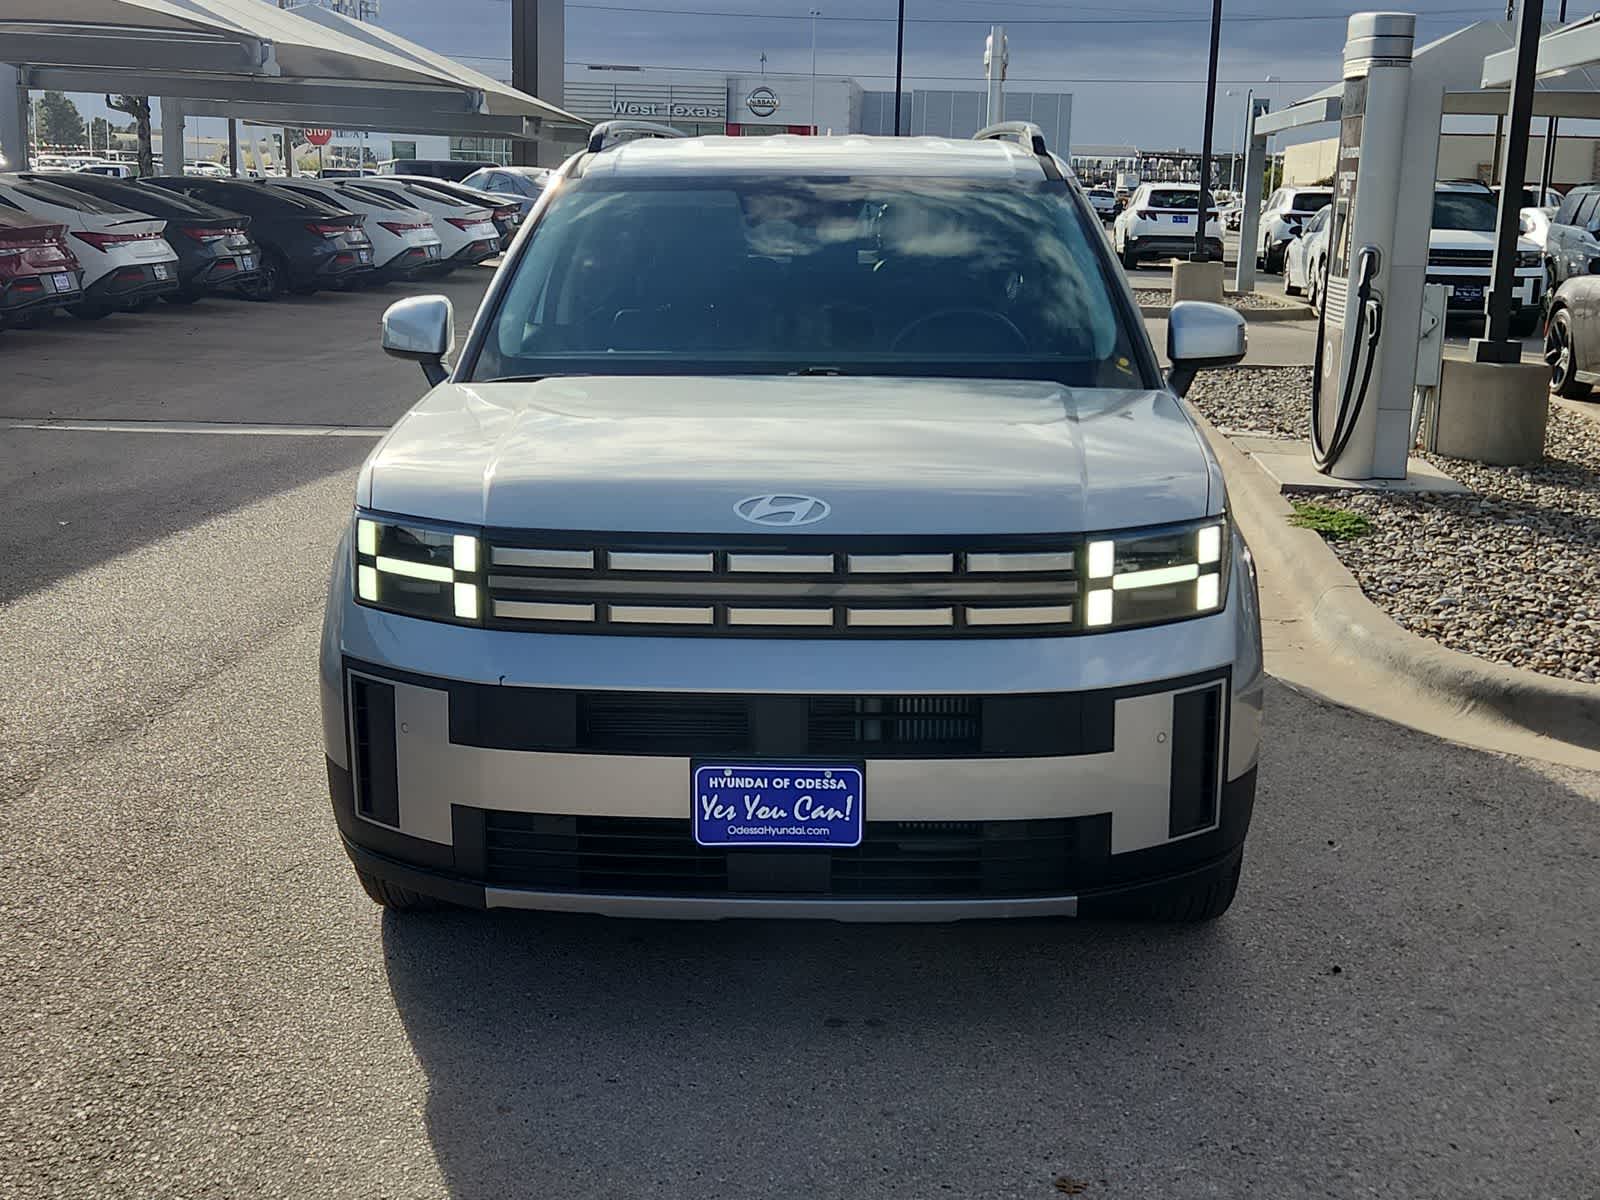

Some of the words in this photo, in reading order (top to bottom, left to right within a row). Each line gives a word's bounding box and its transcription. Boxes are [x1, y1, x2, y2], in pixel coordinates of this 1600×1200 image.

[611, 101, 657, 115] West
[664, 102, 720, 118] Texas
[306, 128, 329, 136] STOP
[709, 777, 768, 788] HYUNDAI
[772, 778, 790, 789] OF
[794, 778, 847, 790] ODESSA
[702, 794, 736, 820] Yes
[744, 794, 787, 821] You
[793, 795, 853, 821] Can!
[727, 825, 830, 837] OdessaHyundai.com
